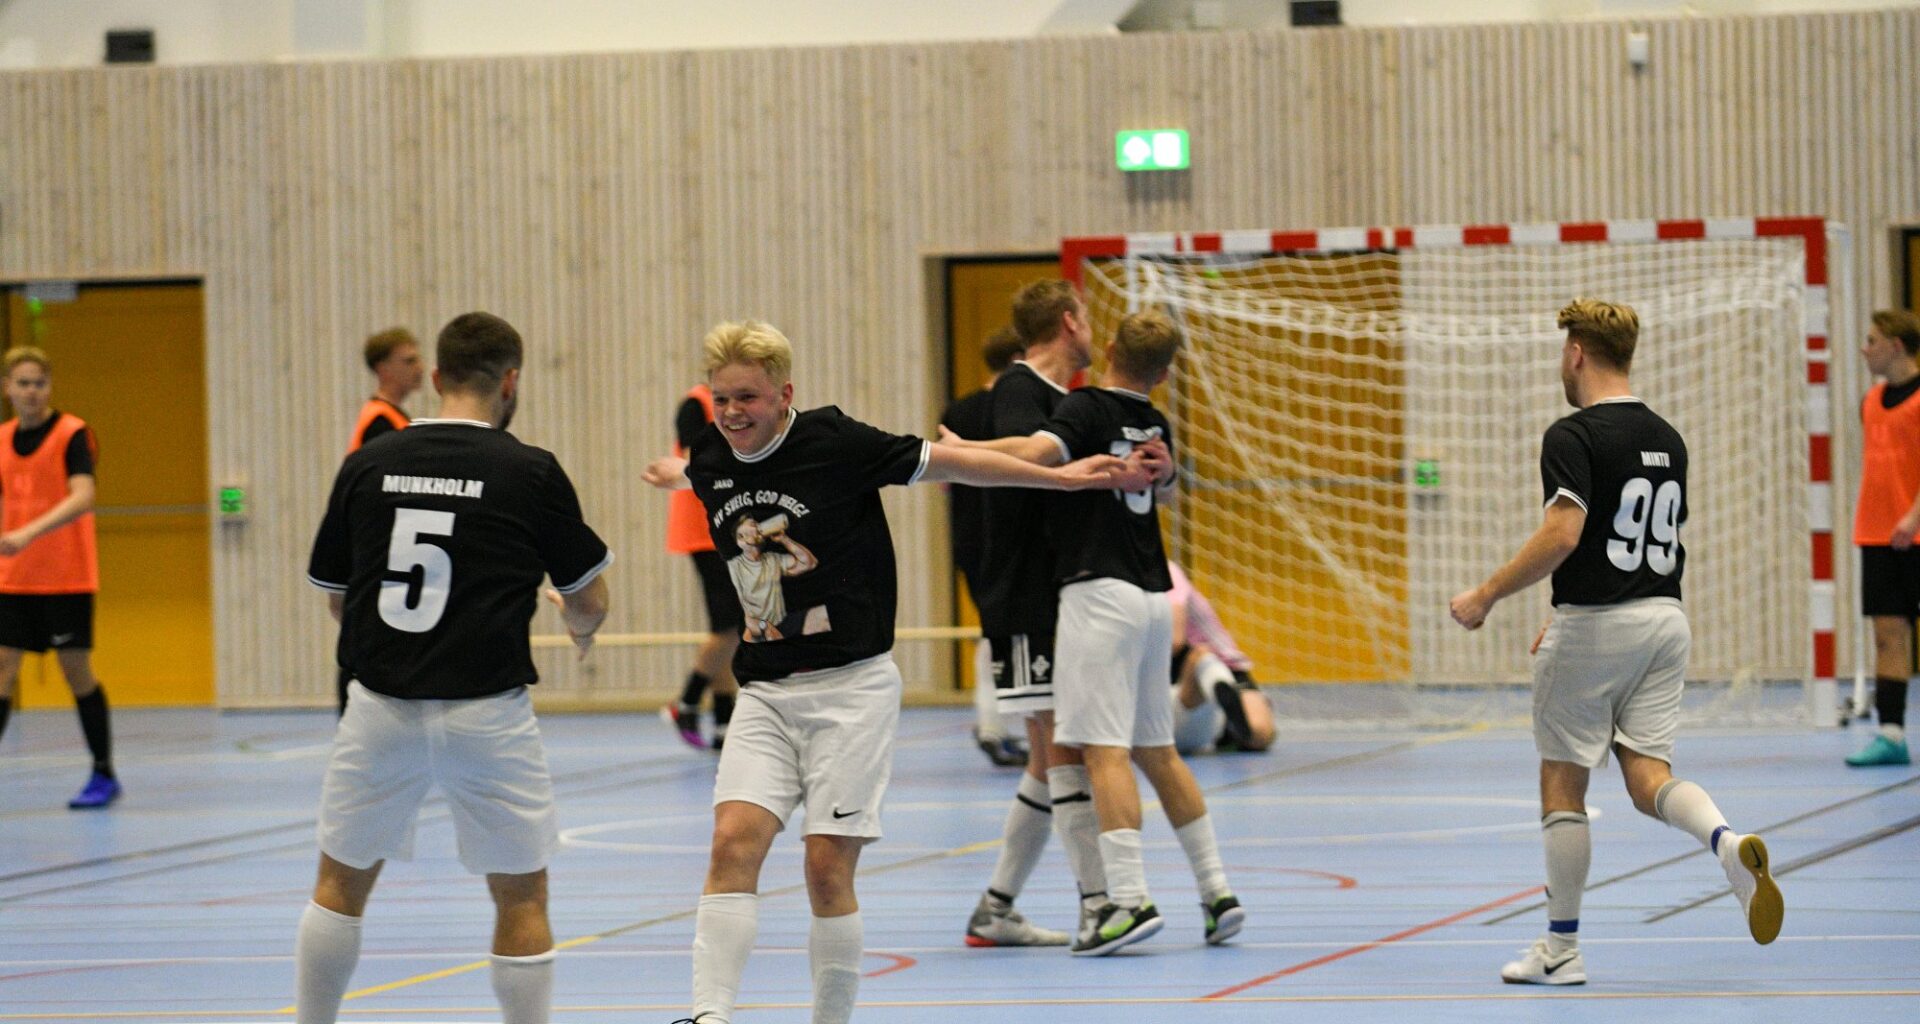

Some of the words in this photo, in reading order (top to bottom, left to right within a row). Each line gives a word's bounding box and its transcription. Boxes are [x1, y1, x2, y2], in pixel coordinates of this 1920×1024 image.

[381, 474, 484, 498] MUNKHOLM
[755, 489, 779, 504] GOD
[777, 494, 810, 518] HELG!
[1606, 477, 1682, 576] 99
[377, 507, 456, 633] 5
